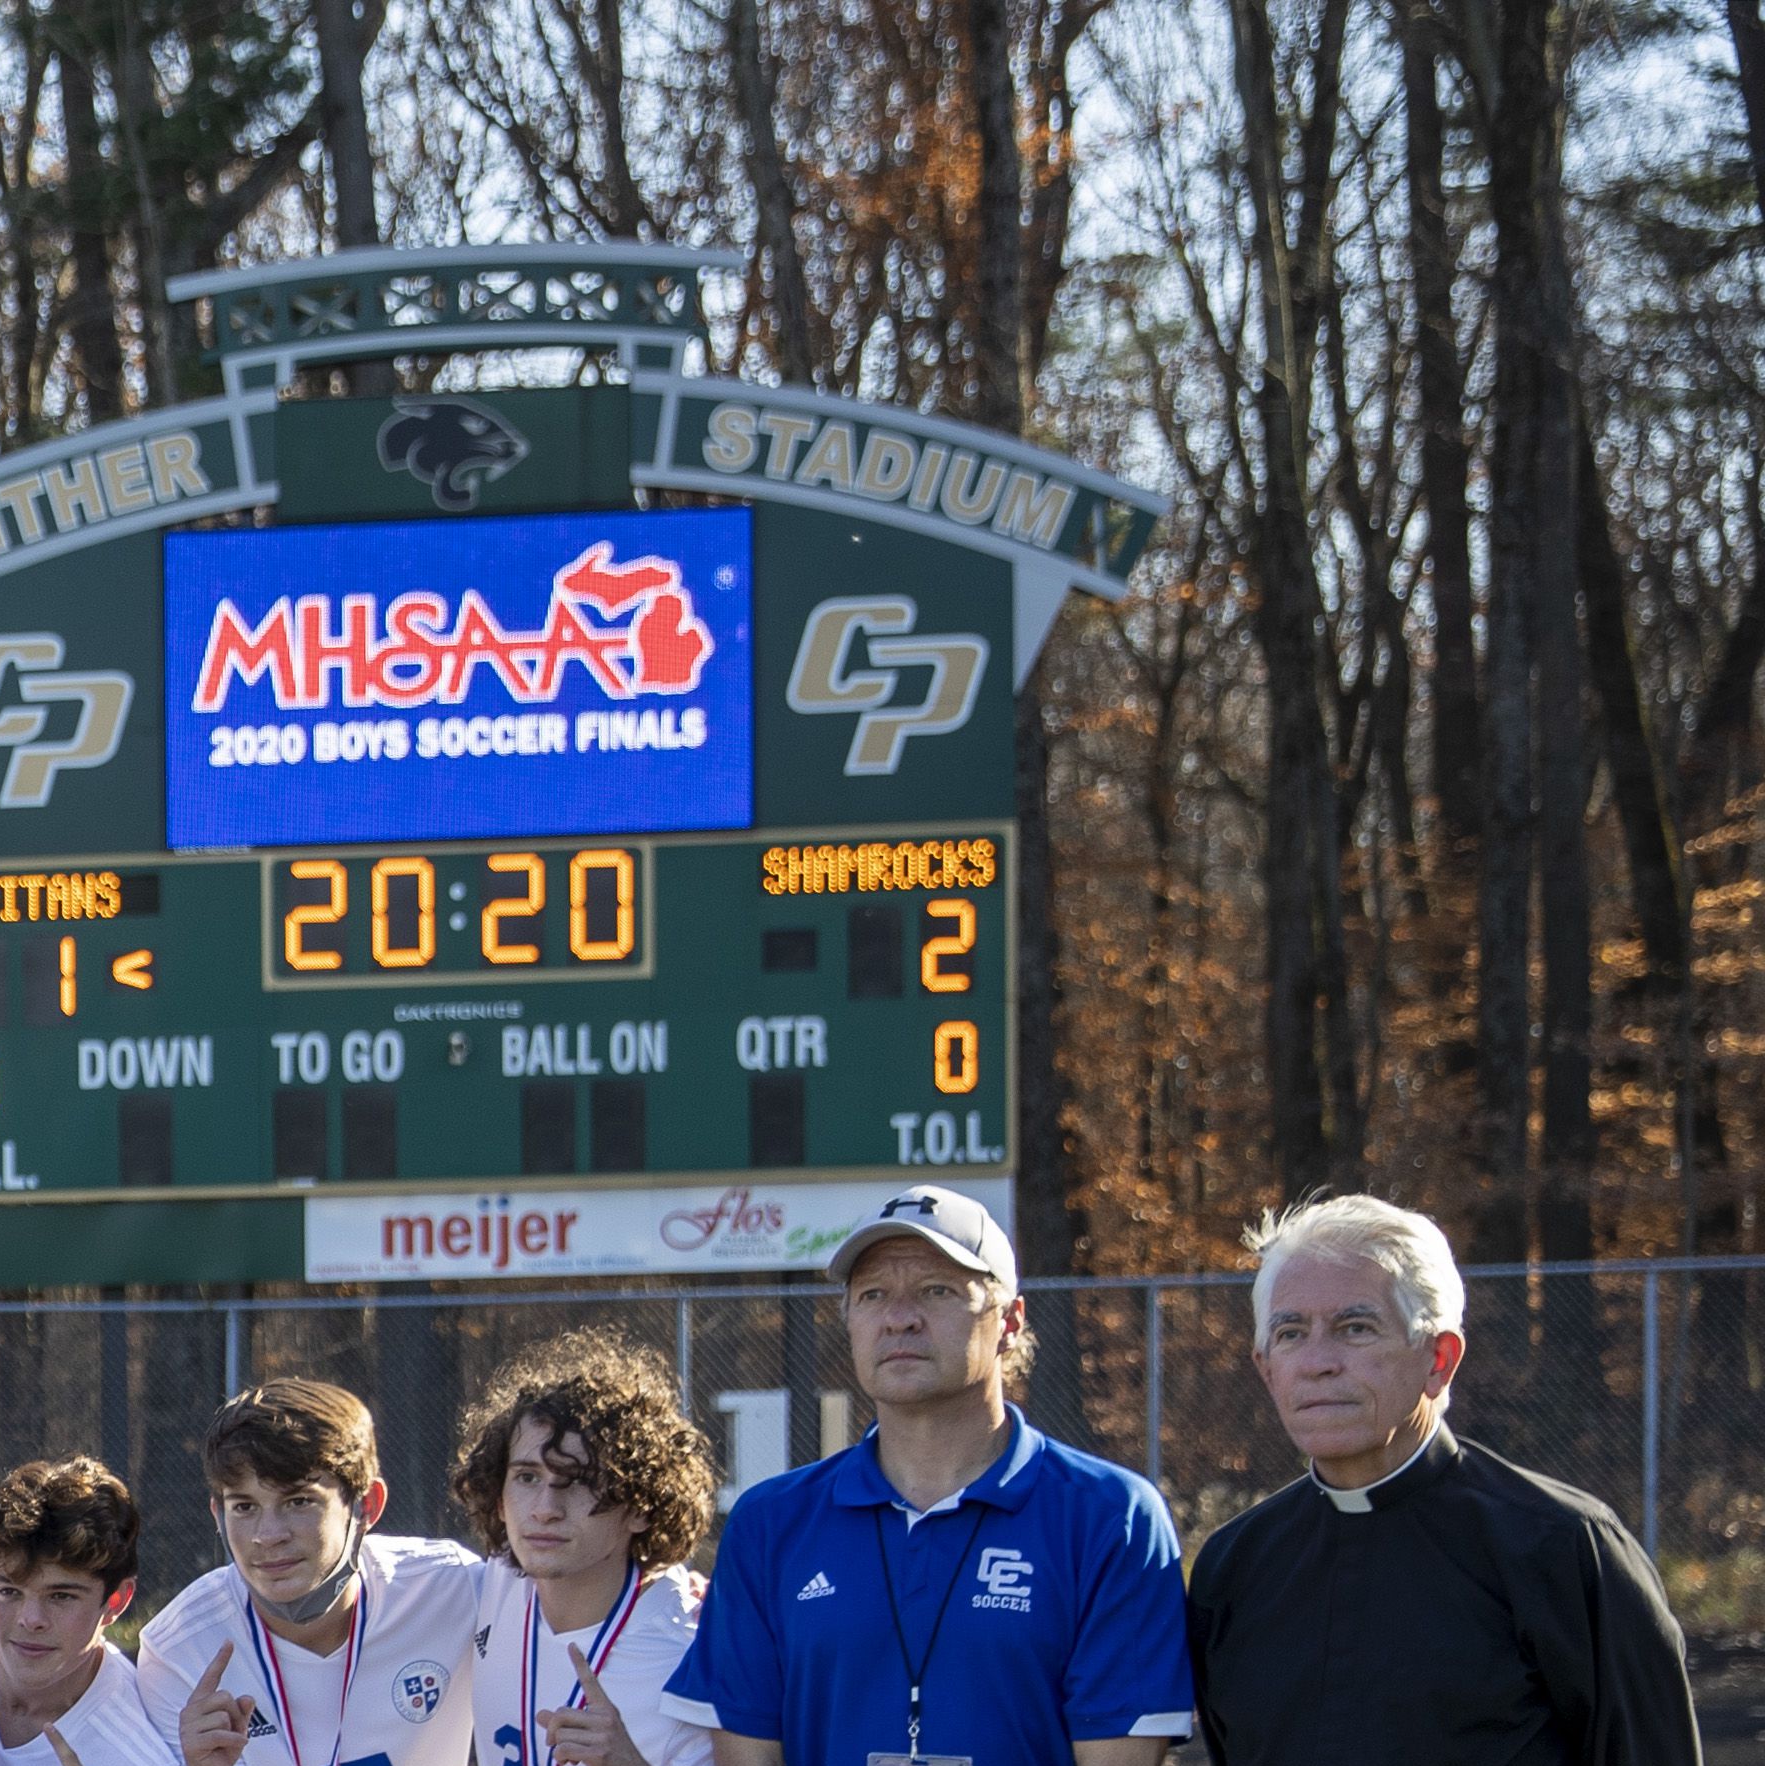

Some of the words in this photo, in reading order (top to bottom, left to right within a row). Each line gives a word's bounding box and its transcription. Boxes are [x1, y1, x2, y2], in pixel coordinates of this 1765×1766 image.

[702, 403, 1076, 552] STADIUM
[191, 590, 649, 712] MHSAA
[209, 727, 305, 768] 2020
[312, 724, 408, 764] BOYS
[414, 717, 569, 760] SOCCER
[574, 709, 709, 753] FINALS
[761, 838, 997, 897] SHAMROCKS
[283, 848, 638, 972] 20:20
[919, 898, 976, 994] 2
[393, 1002, 523, 1021] DAKTRONICS
[76, 1036, 214, 1090] DOWN
[271, 1032, 331, 1083] TO
[340, 1030, 405, 1083] GO
[501, 1024, 601, 1077] BALL
[608, 1021, 668, 1074] ON
[736, 1016, 828, 1072] QTR
[934, 1020, 980, 1095] 0
[890, 1113, 1003, 1166] T.O.L.
[380, 1196, 579, 1270] meijer
[796, 1585, 836, 1601] adidas
[972, 1594, 1031, 1613] SOCCER
